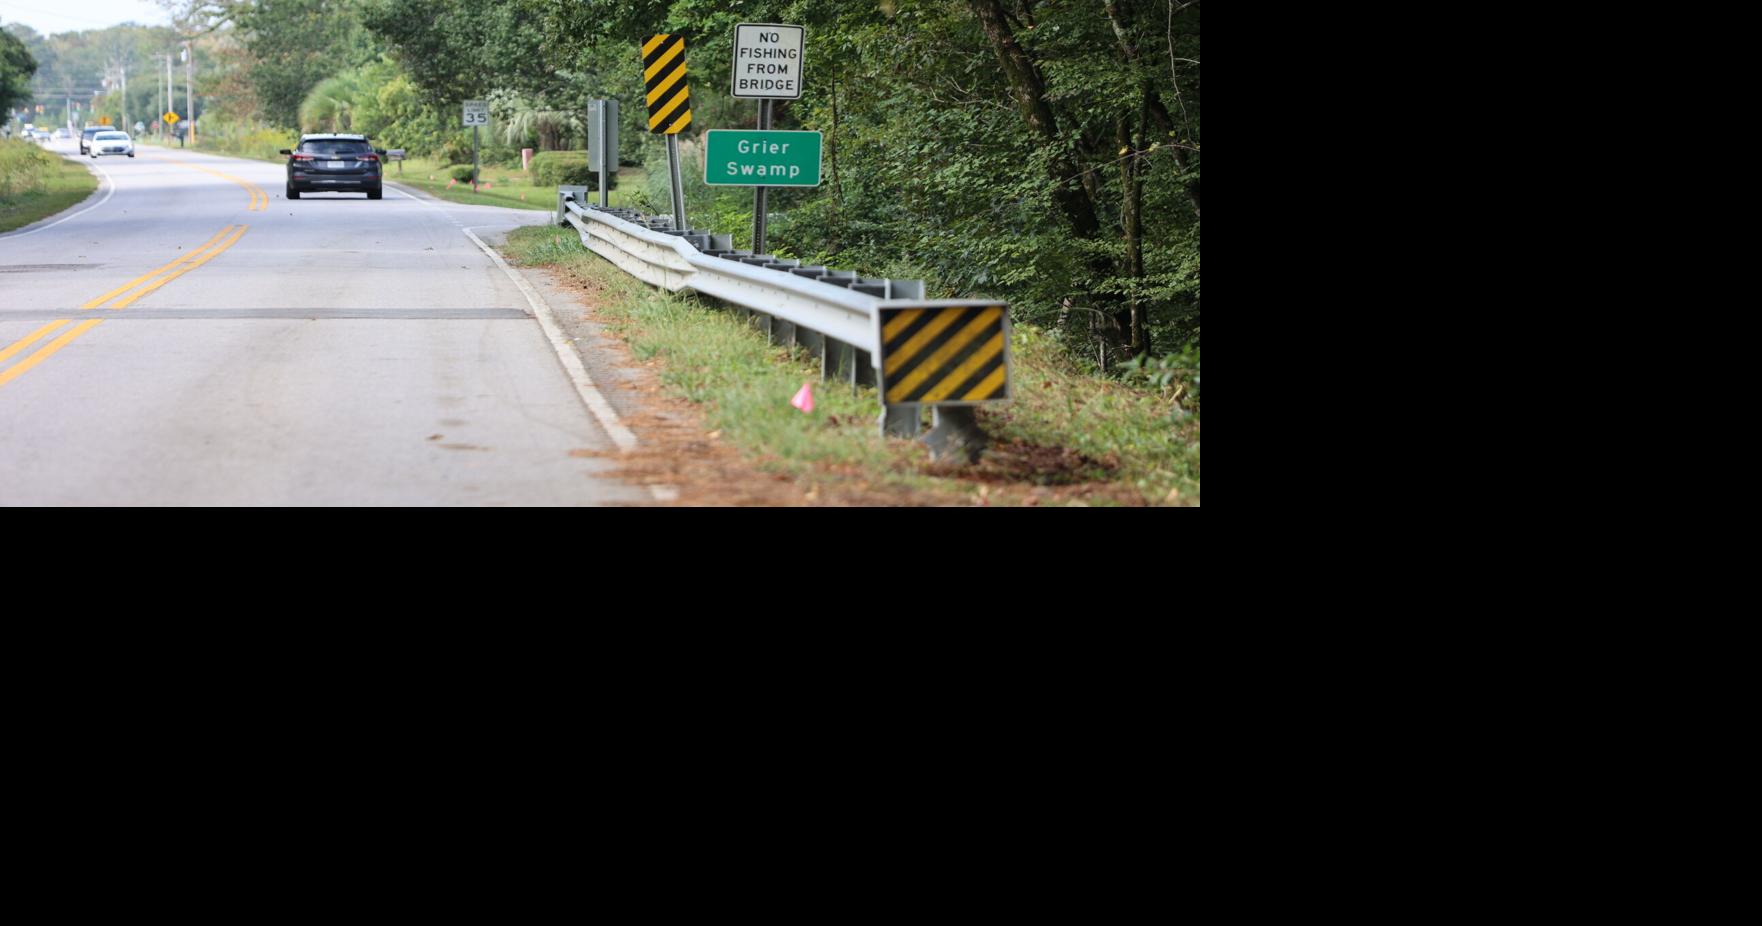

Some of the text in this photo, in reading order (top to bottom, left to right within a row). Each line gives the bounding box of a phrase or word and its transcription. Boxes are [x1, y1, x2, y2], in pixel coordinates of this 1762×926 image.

[760, 32, 779, 43] NO
[740, 48, 797, 59] FISHING
[747, 64, 788, 74] FROM
[739, 79, 794, 90] BRIDGE
[465, 113, 487, 123] 35
[738, 140, 790, 154] Grier
[727, 162, 800, 178] Swamp
